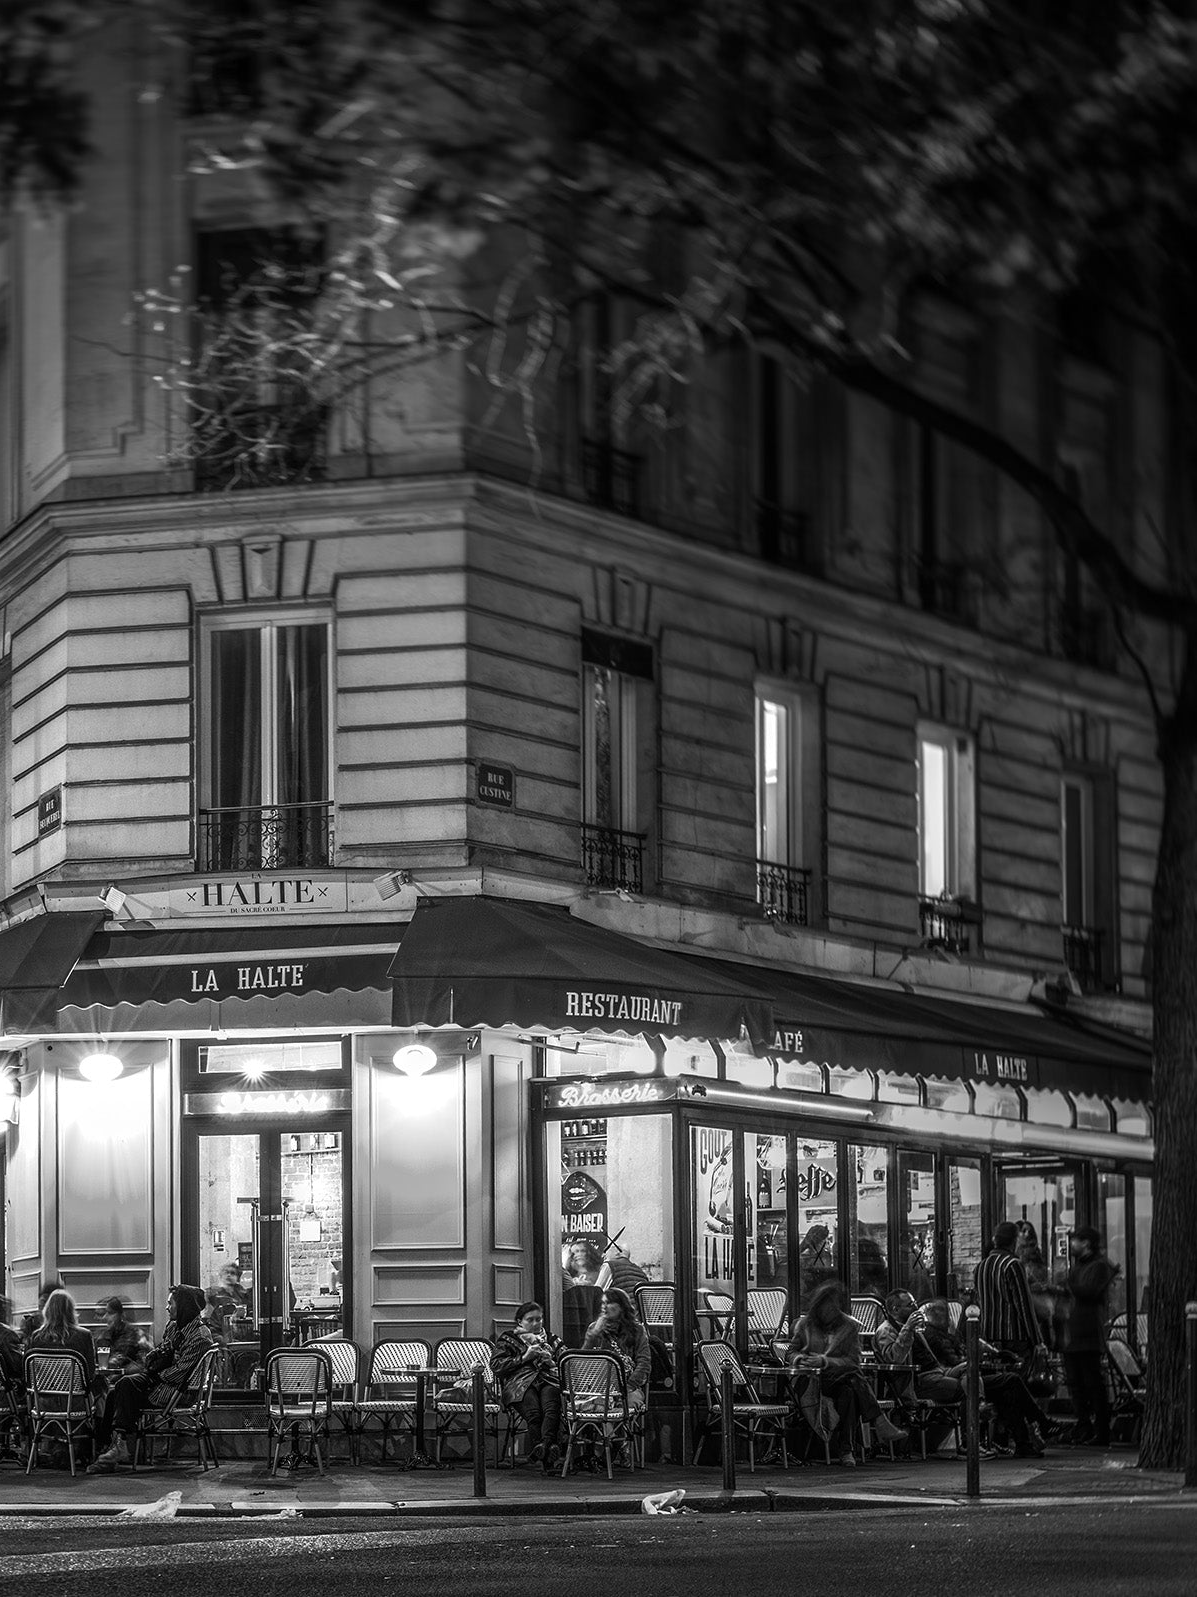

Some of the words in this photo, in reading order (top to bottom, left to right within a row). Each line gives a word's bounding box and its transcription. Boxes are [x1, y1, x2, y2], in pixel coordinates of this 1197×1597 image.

[487, 772, 505, 785] RUE
[479, 785, 512, 801] CUSTINE
[201, 879, 315, 907] HALTE
[191, 969, 219, 992] LA
[237, 965, 304, 990] HALTE
[566, 991, 682, 1026] RESTAURANT
[772, 1030, 803, 1053] AFÉ
[974, 1052, 990, 1076] LA
[996, 1055, 1028, 1081] HALTE
[558, 1082, 660, 1107] Brasserie
[570, 1213, 604, 1233] BAISER
[705, 1236, 719, 1279] LA
